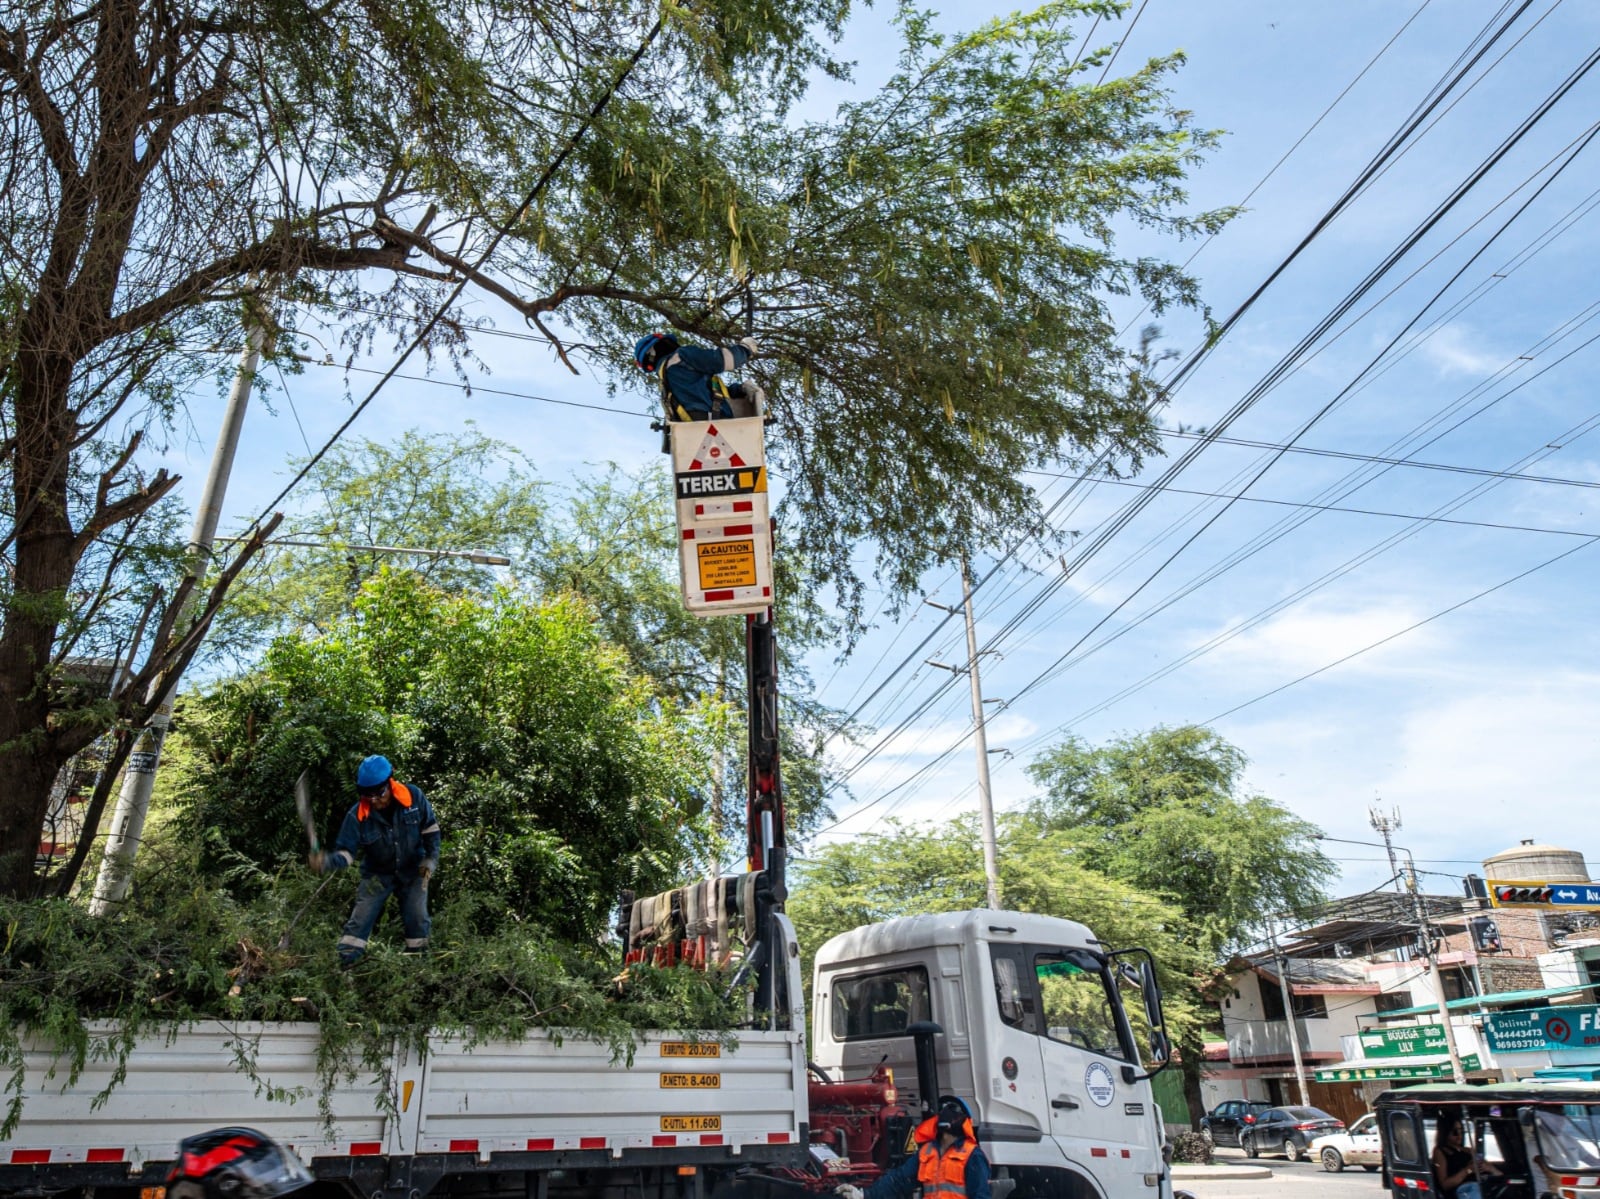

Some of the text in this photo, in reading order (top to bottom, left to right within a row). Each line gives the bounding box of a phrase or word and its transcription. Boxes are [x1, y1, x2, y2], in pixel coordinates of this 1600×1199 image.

[678, 474, 737, 494] TEREX
[711, 544, 749, 554] CAUTION
[1498, 1020, 1532, 1029] Delivery
[1387, 1029, 1420, 1041] BODEGA
[1398, 1041, 1414, 1052] LILY
[663, 1075, 718, 1086] P.NETO: 8.400
[690, 1118, 719, 1129] 11.600
